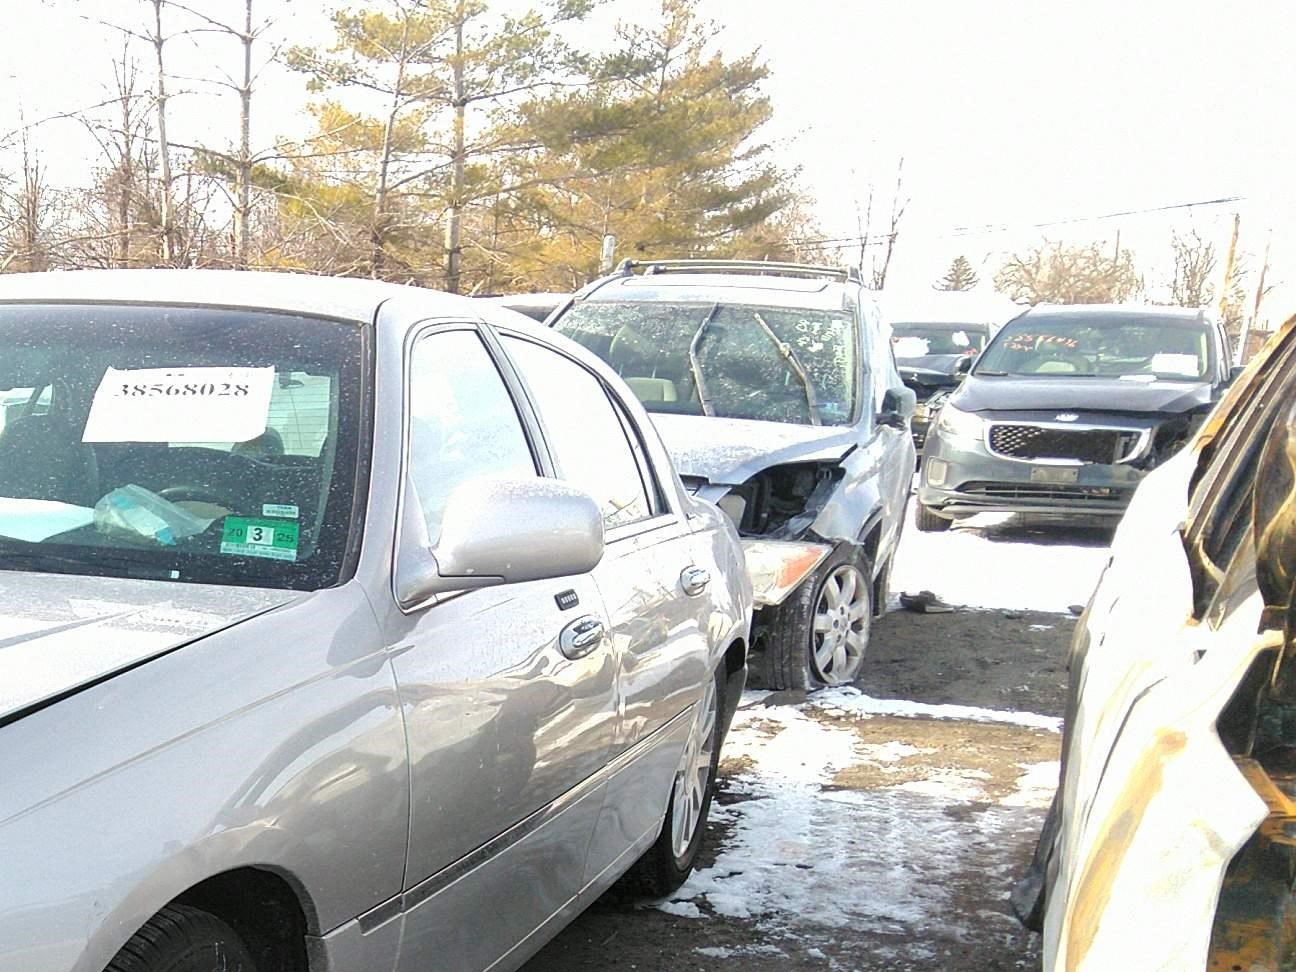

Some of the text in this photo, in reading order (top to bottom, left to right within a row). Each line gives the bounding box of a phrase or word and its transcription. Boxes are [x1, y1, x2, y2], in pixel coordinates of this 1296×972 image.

[114, 383, 250, 397] 38568028
[227, 527, 294, 543] 20 3 25
